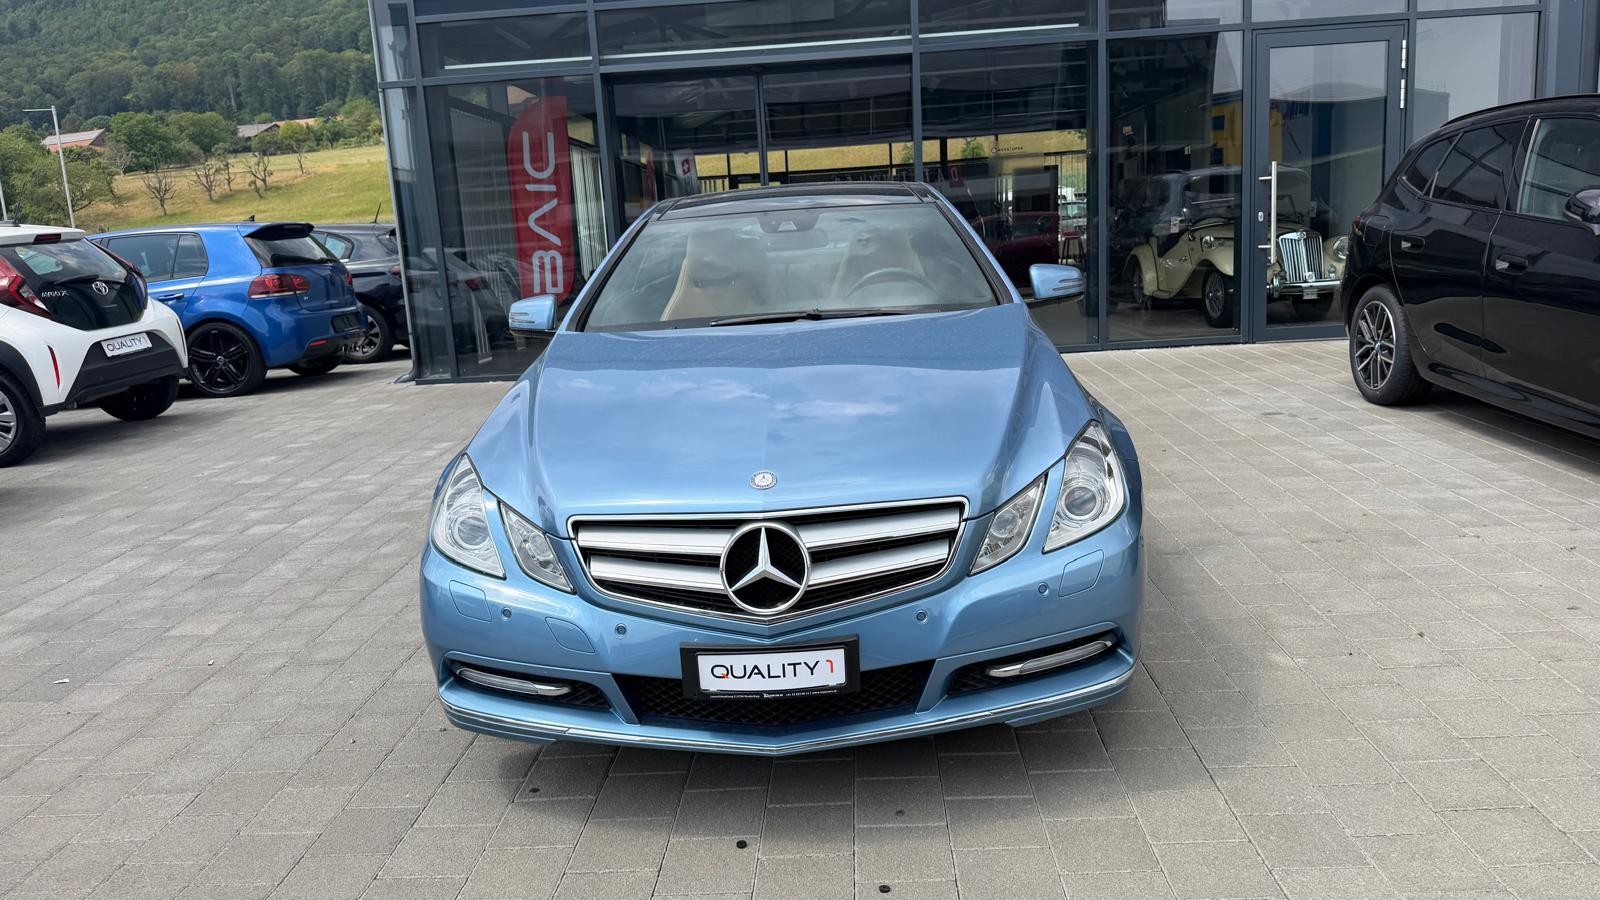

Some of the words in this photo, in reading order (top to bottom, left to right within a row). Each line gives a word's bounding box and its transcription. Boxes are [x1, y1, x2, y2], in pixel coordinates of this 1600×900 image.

[522, 131, 564, 294] BAIC
[106, 337, 142, 351] QUALITY
[710, 660, 820, 679] QUALITY
[825, 659, 834, 673] 1
